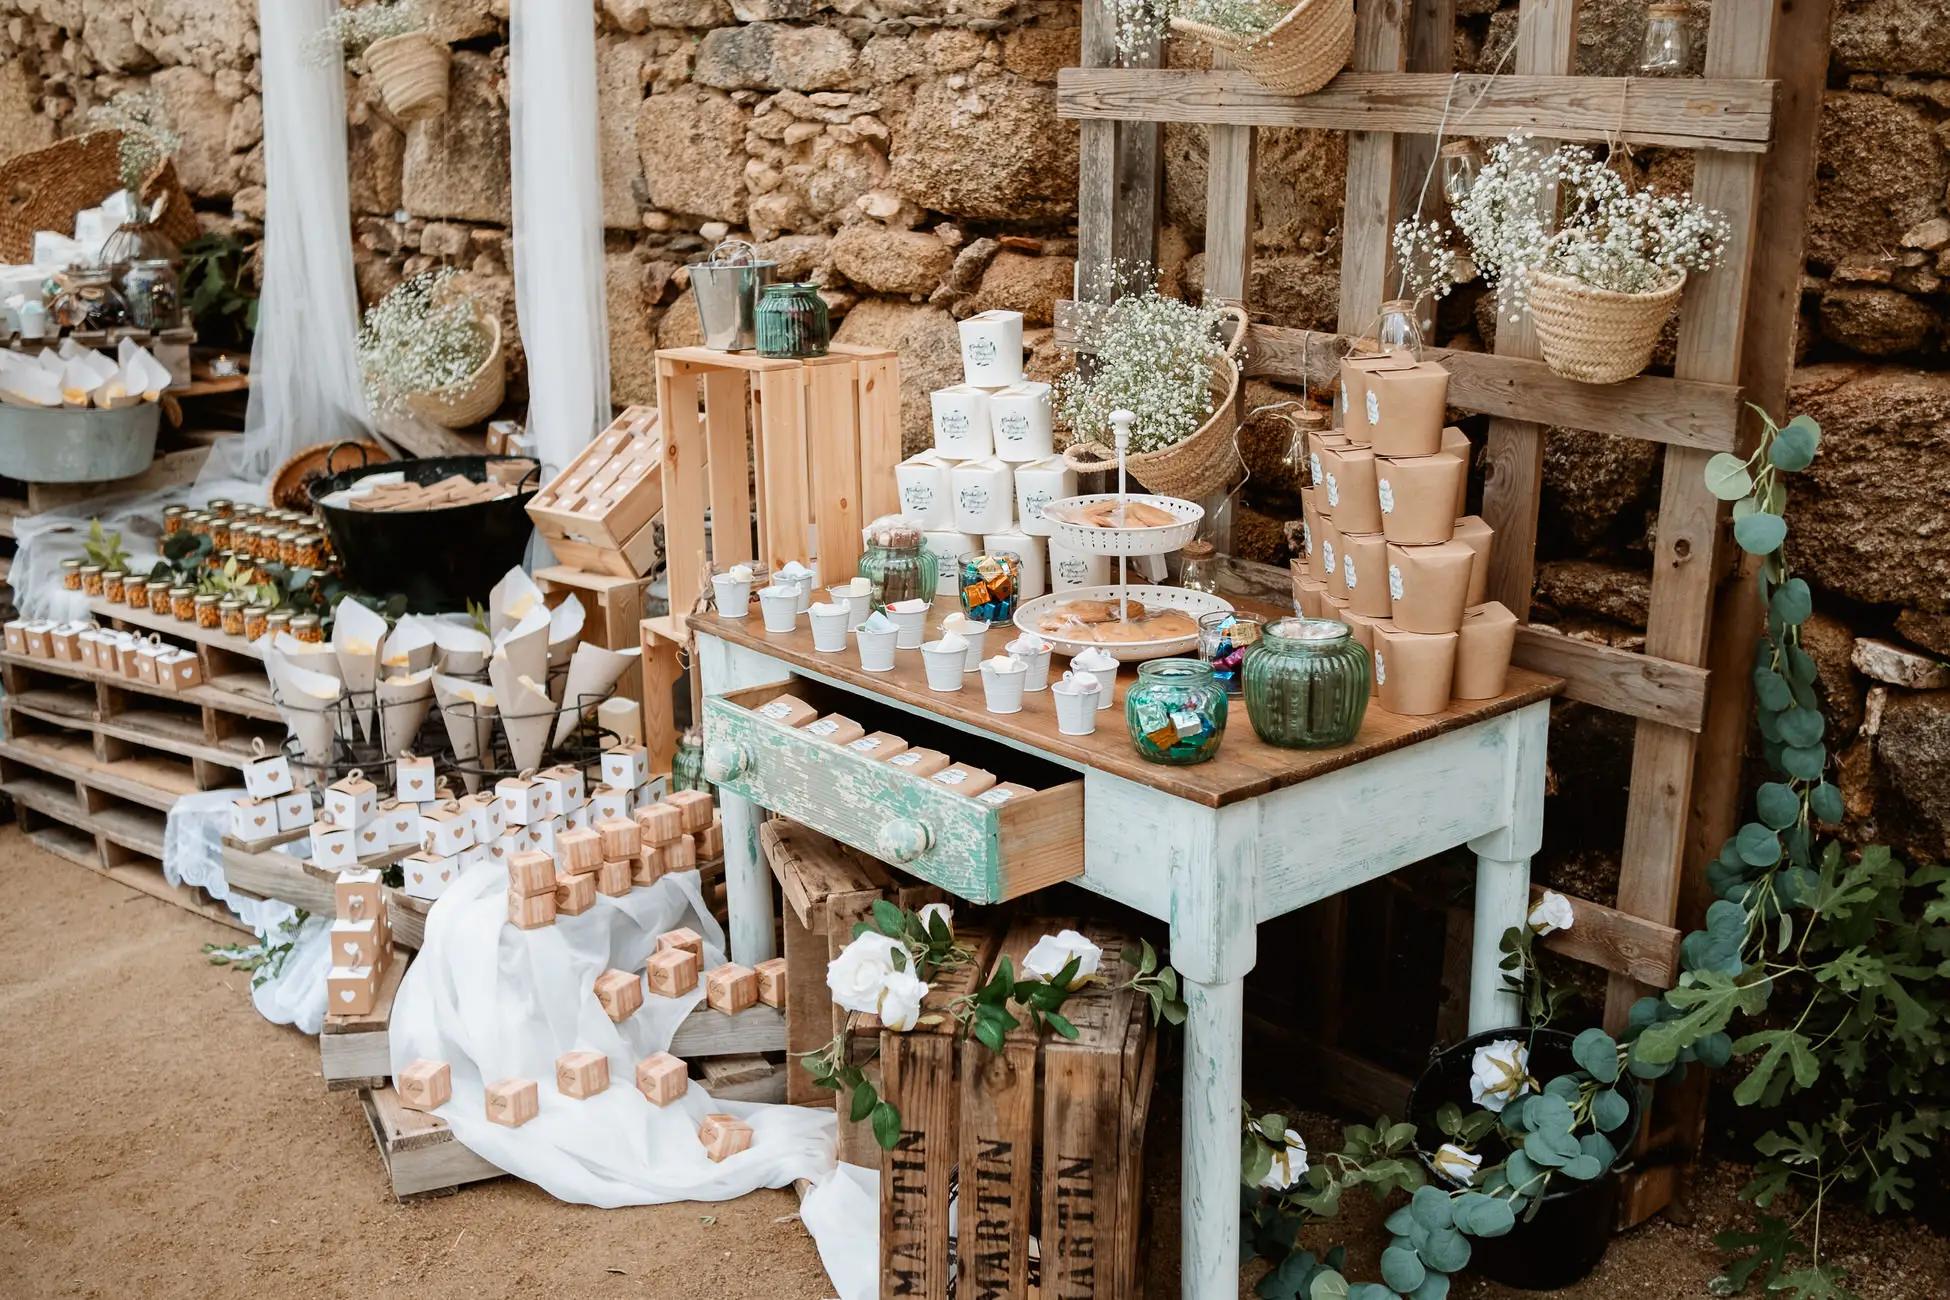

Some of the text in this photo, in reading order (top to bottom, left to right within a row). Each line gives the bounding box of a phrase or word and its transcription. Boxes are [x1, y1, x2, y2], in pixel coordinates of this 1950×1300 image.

[892, 1130, 927, 1298] MARTIN
[976, 1135, 1013, 1300] MARTIN
[1057, 1154, 1095, 1300] ARTIN
